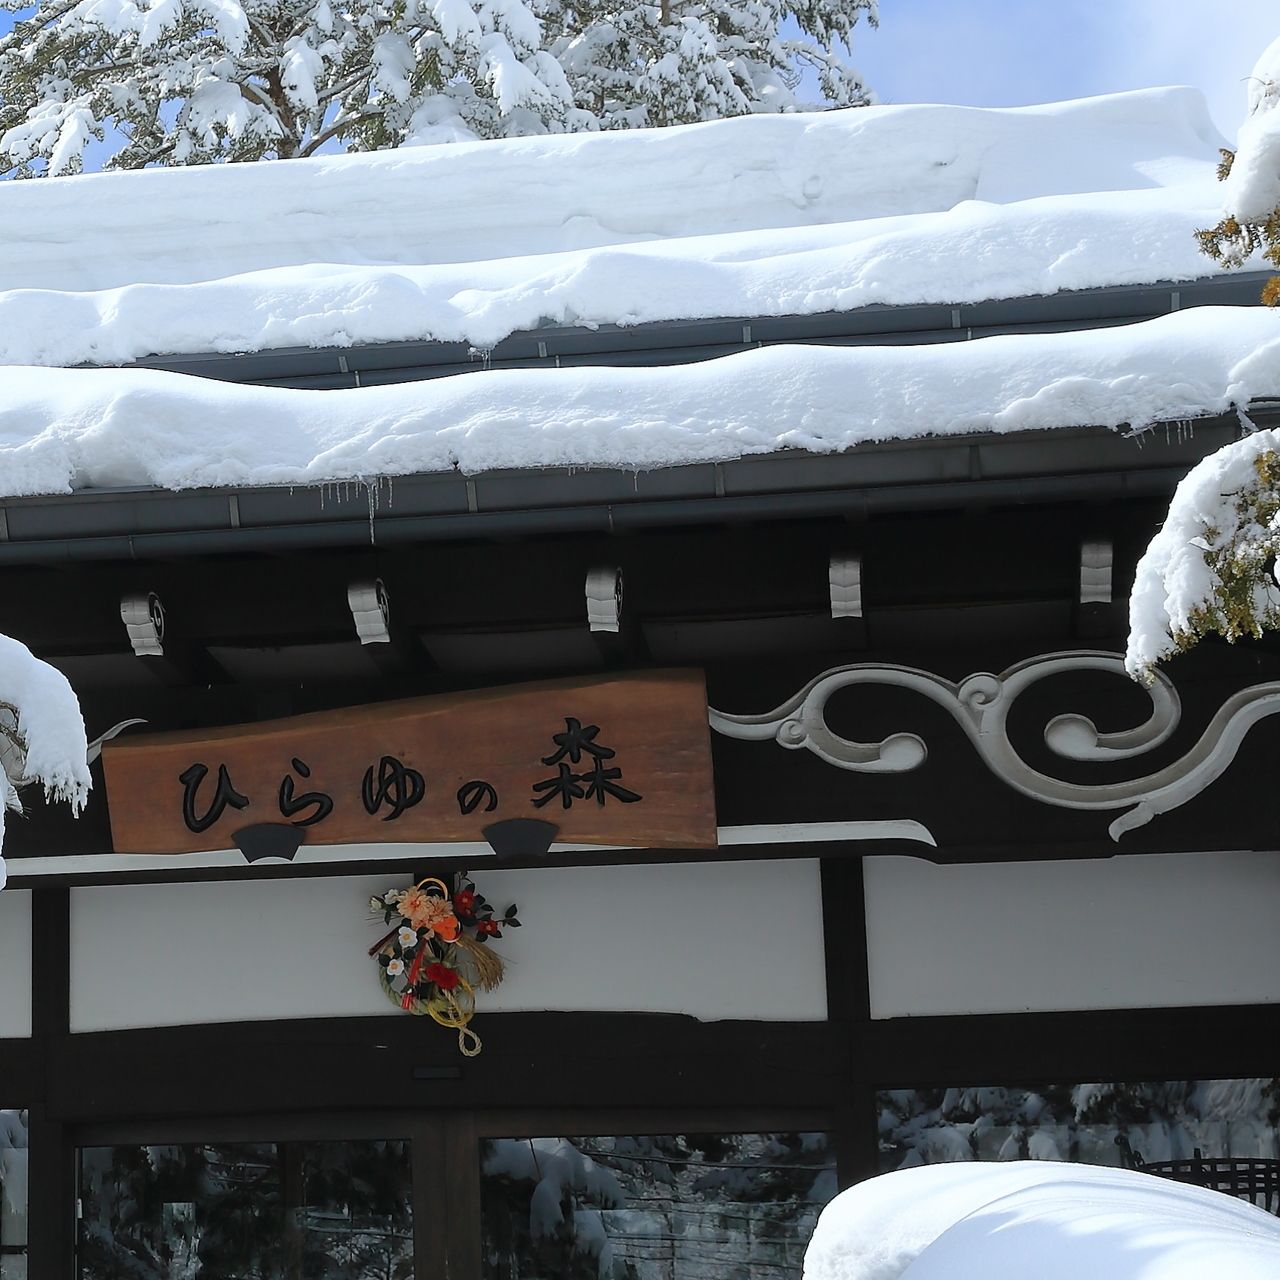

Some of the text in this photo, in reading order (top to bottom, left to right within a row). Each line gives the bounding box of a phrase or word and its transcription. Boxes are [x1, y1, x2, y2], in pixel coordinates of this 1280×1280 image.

[179, 717, 643, 834] ひらゆの森
